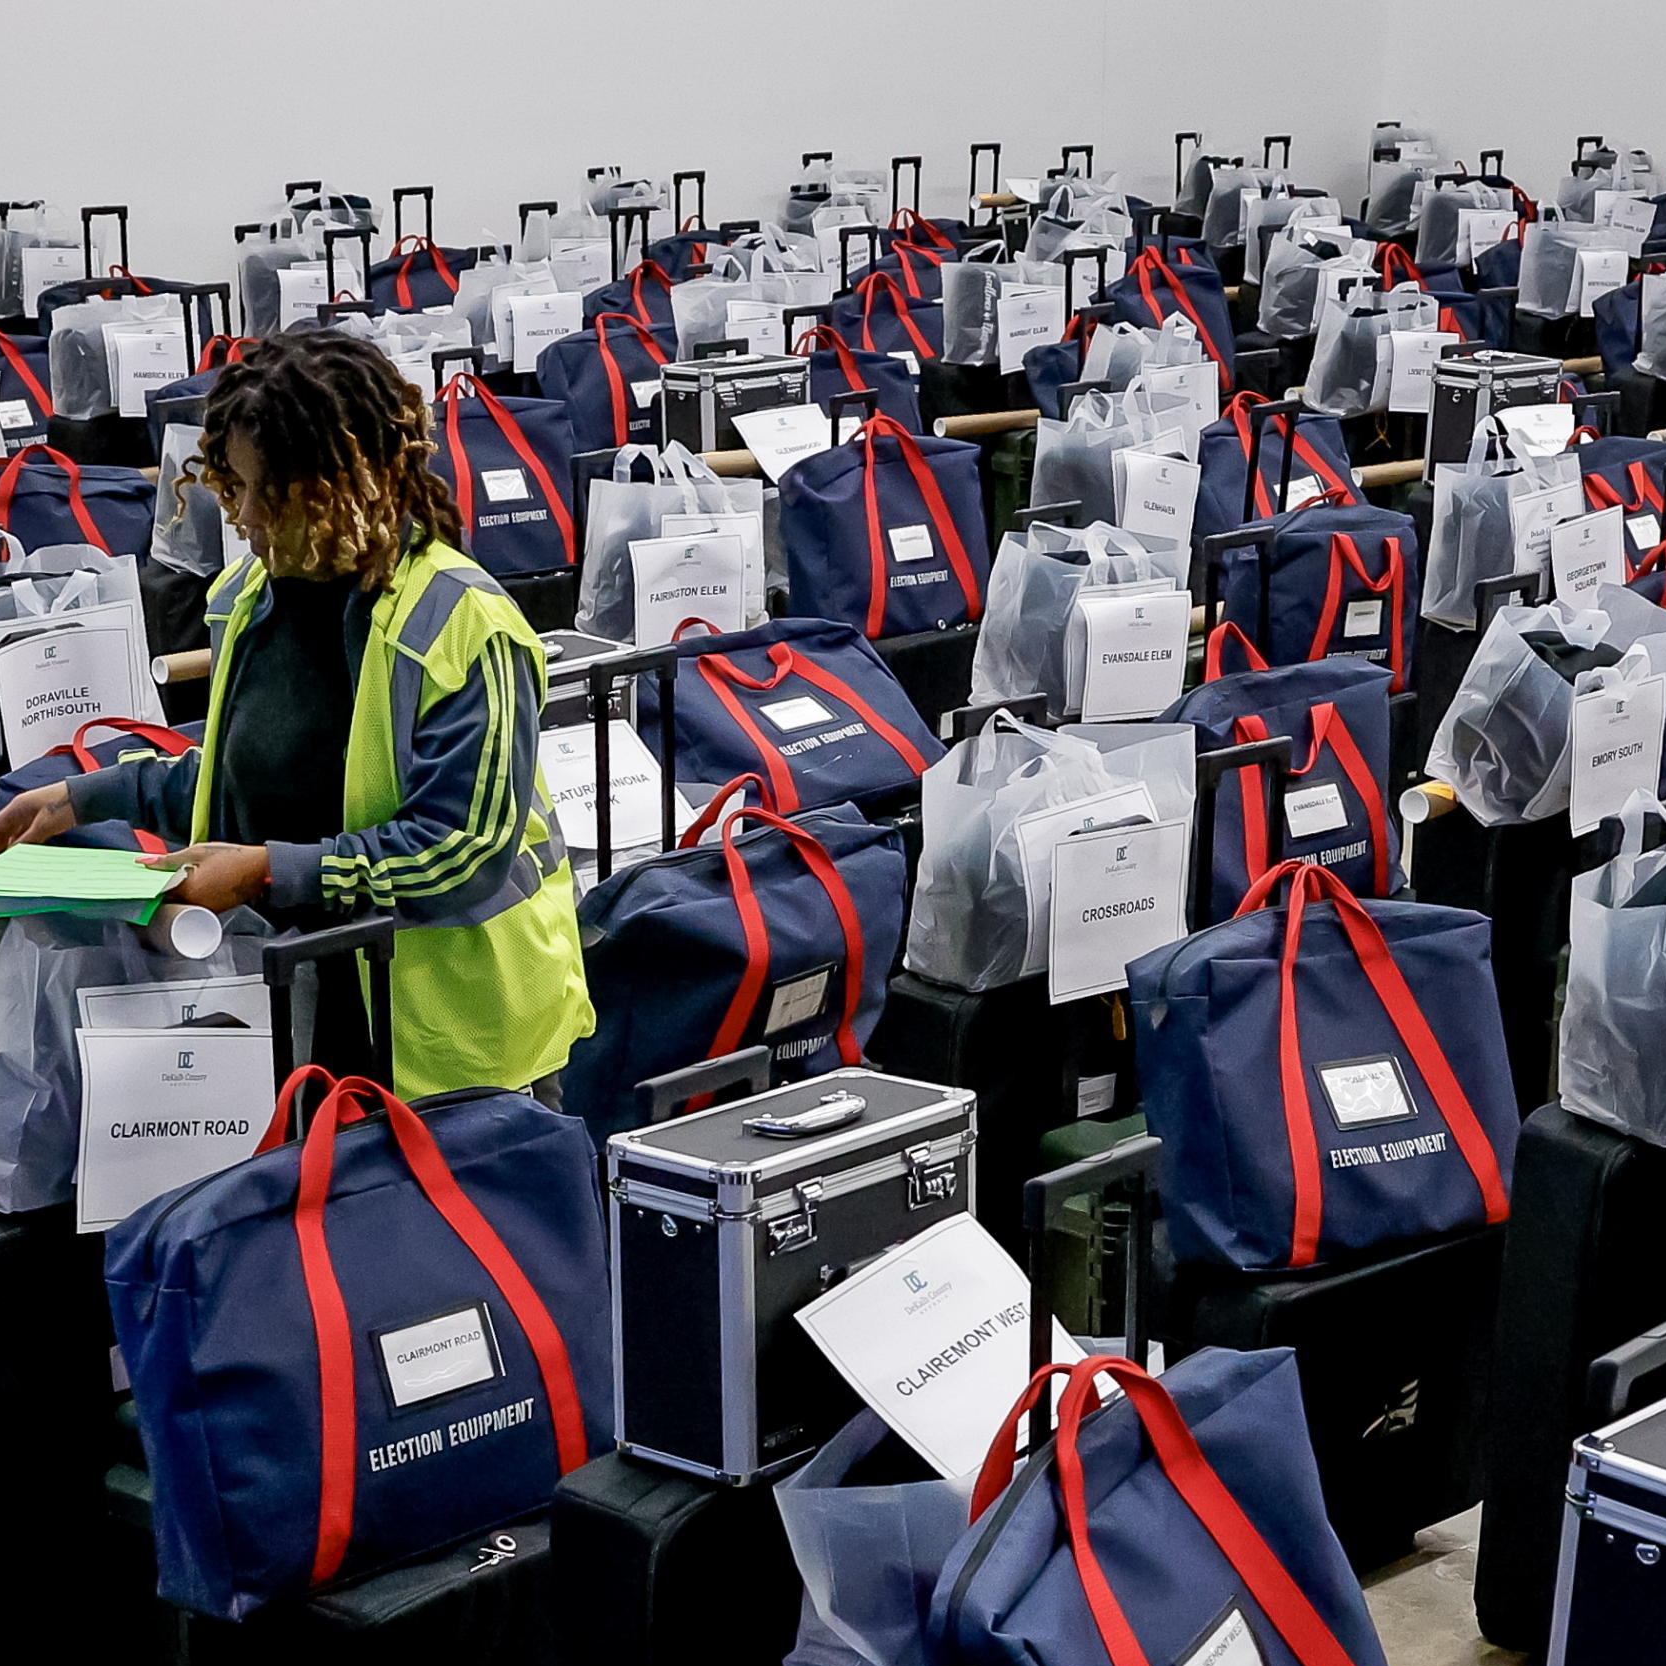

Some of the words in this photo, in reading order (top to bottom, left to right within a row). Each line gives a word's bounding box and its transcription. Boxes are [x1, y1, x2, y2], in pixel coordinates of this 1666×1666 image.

[478, 511, 510, 526] ELECTION
[511, 509, 547, 522] EQUIPMENT
[890, 572, 916, 588] ELECTION
[918, 569, 948, 585] EQUIPMENT
[1566, 561, 1607, 582] GEORGETOWN
[650, 585, 698, 604] FAIRINGTON
[701, 583, 727, 597] ELEM
[1575, 577, 1598, 593] SQUARE
[1102, 651, 1149, 666] EVANSDALE
[1150, 649, 1172, 662] ELEM
[26, 685, 90, 710] DORAVILLE
[21, 701, 102, 728] NORTH/SOUTH
[779, 739, 818, 756] ELECTION
[821, 723, 867, 746] EQUIPMENT
[1592, 749, 1618, 768] EMORY
[1618, 742, 1643, 760] SOUTH
[1319, 841, 1367, 865] EQUIPMENT
[1081, 895, 1155, 924] CROSSROADS
[776, 1034, 827, 1062] EQUIPME
[110, 1121, 200, 1139] CLAIRMONT
[203, 1119, 249, 1137] ROAD
[1331, 1143, 1381, 1169] ELECTION
[1384, 1132, 1447, 1163] EQUIPMENT
[397, 1336, 452, 1367] CLAIRMONT
[454, 1329, 482, 1348] ROAD
[895, 1317, 998, 1399] CLAIREMONT
[995, 1300, 1030, 1334] WEST
[368, 1430, 444, 1474] ELECTION
[448, 1397, 535, 1448] EQUIPMENT
